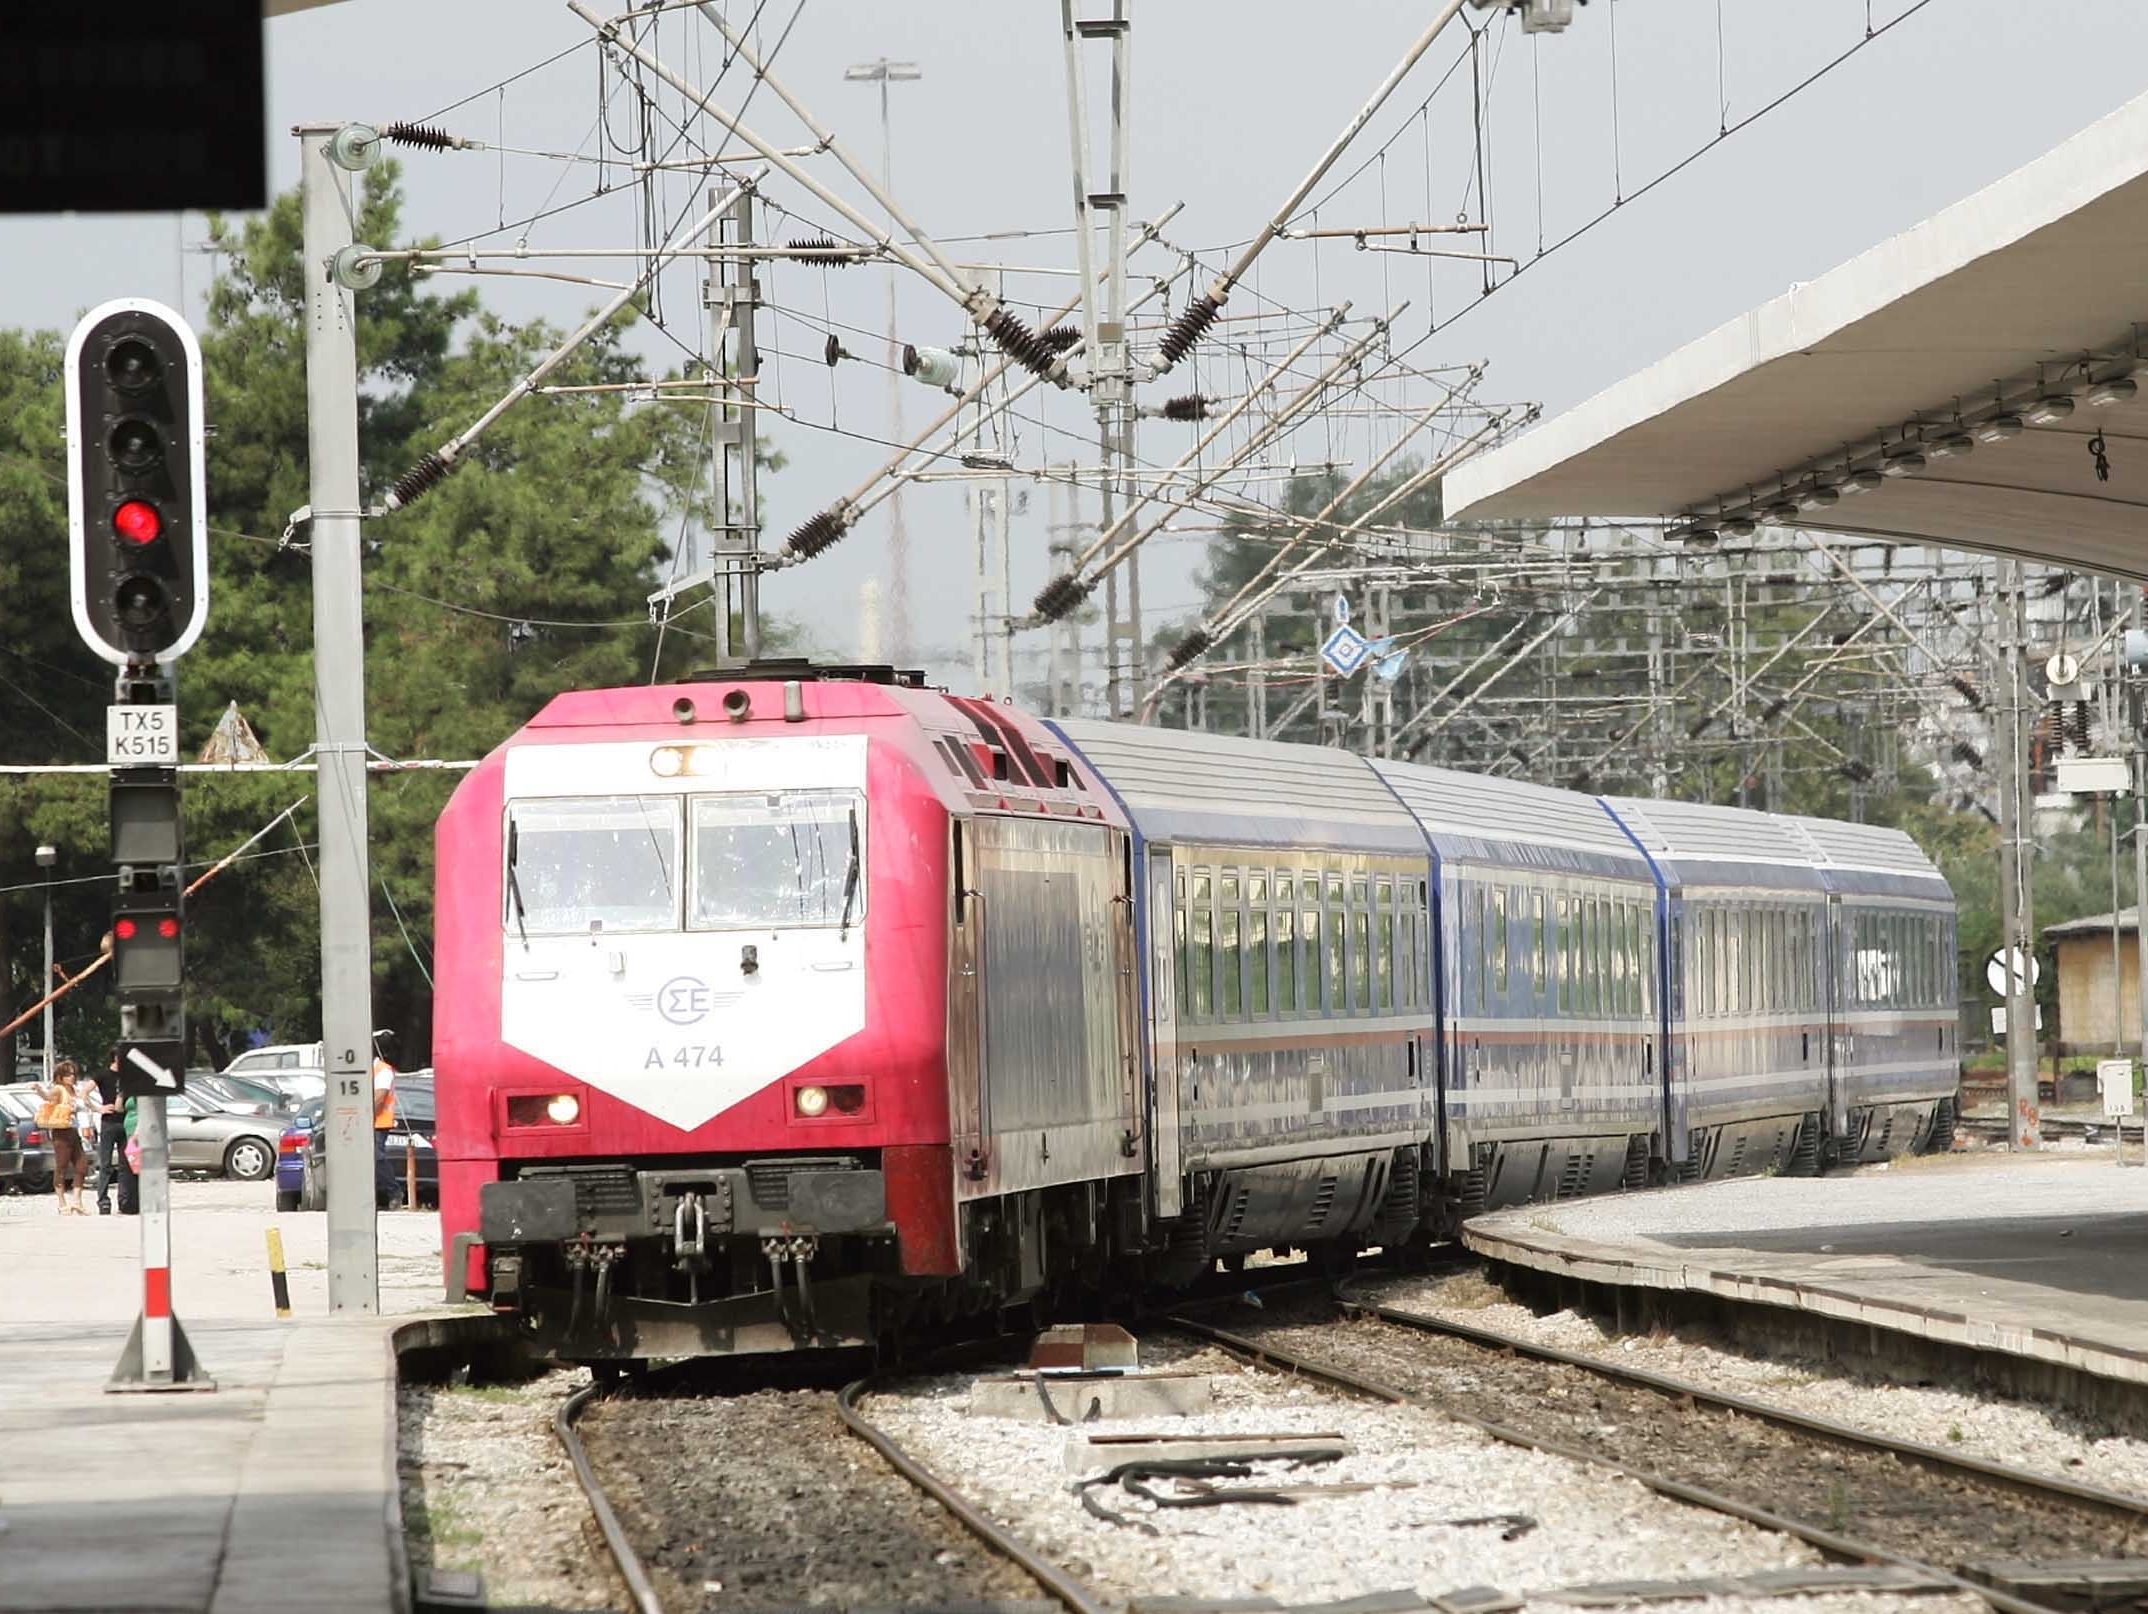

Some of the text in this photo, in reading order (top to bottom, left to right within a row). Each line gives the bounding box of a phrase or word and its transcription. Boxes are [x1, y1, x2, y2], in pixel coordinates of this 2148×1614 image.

[120, 712, 164, 730] TX5
[115, 736, 170, 755] K515
[643, 1045, 724, 1069] A 474
[340, 1080, 360, 1096] 15
